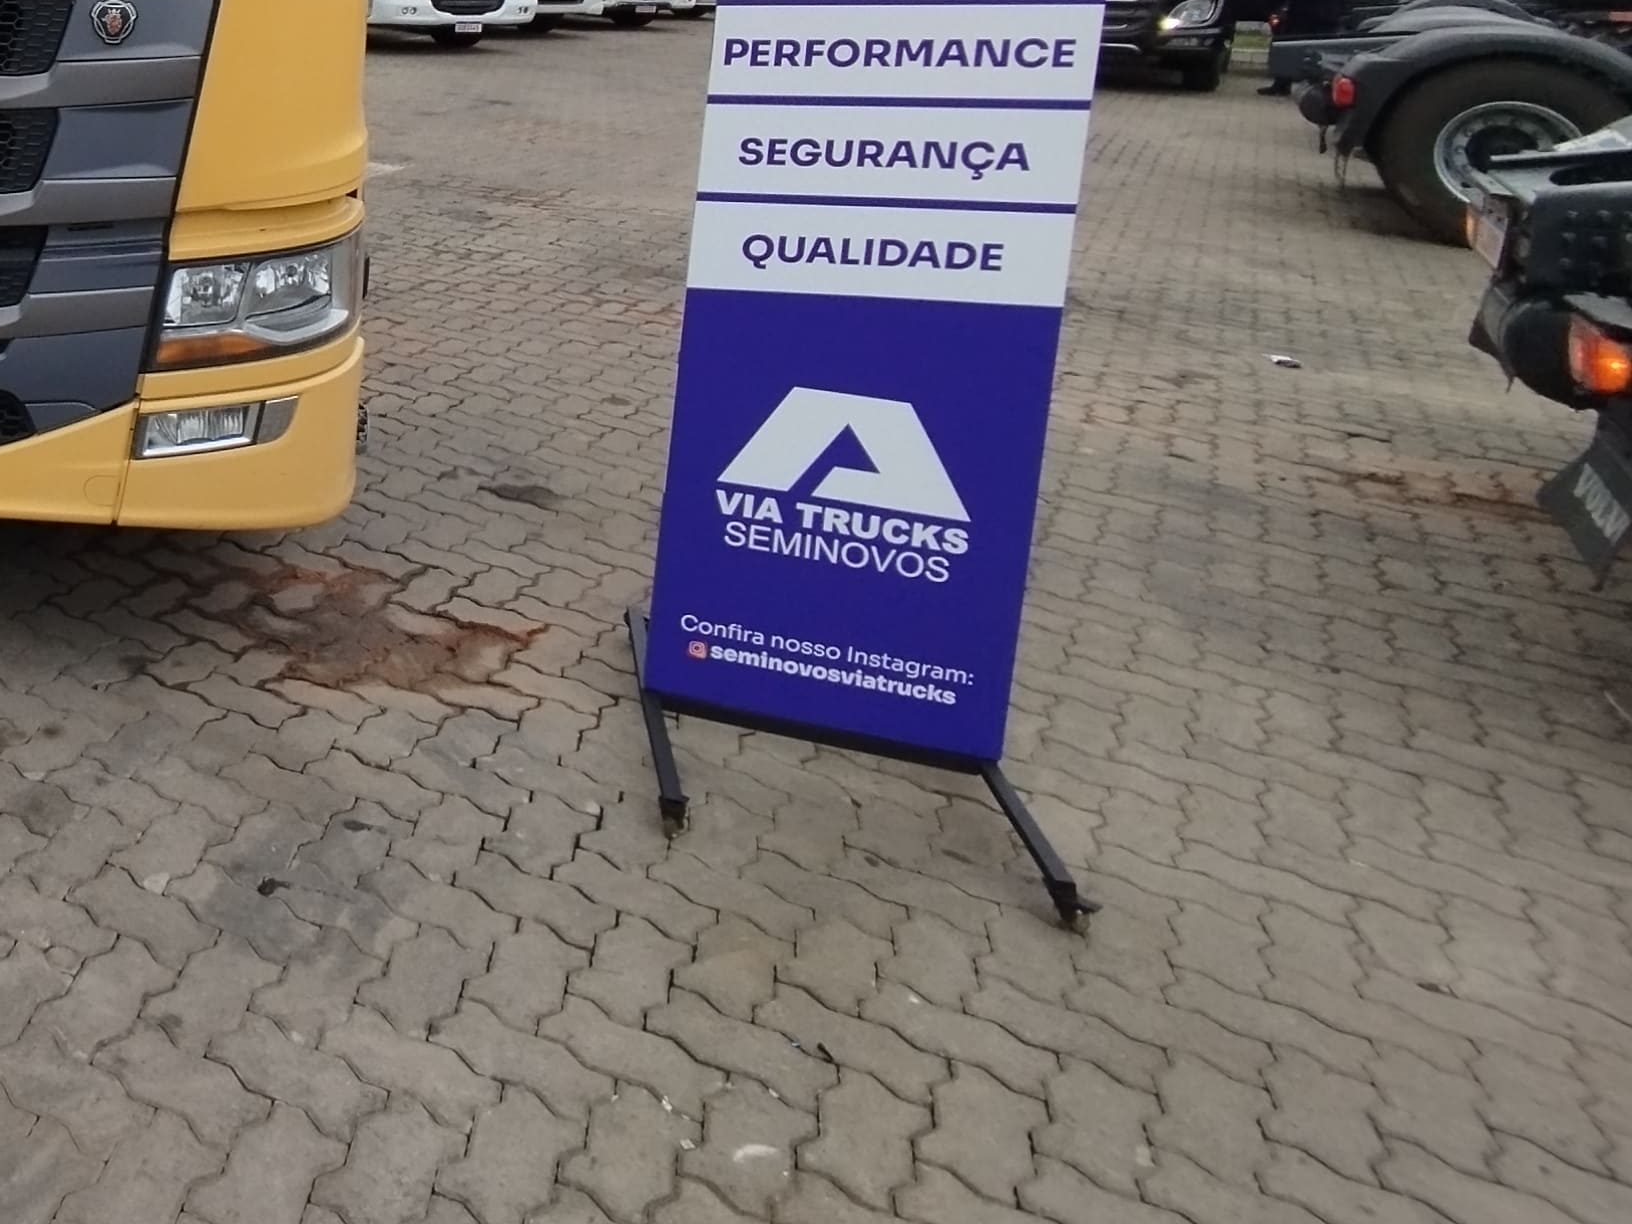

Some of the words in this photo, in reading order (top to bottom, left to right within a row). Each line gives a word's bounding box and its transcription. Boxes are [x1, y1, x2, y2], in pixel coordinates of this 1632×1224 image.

[723, 37, 1077, 68] PERFORMANCE
[738, 137, 1030, 180] SEGURANÇA
[742, 234, 1005, 272] QUALIDADE
[716, 489, 783, 524] VIA
[796, 502, 969, 555] TRUCKS
[724, 521, 950, 583] SEMINOVOS
[680, 614, 764, 646] Confira
[771, 632, 841, 660] nosso
[848, 645, 975, 686] Instagram:
[709, 644, 957, 705] seminovosviatrucks
